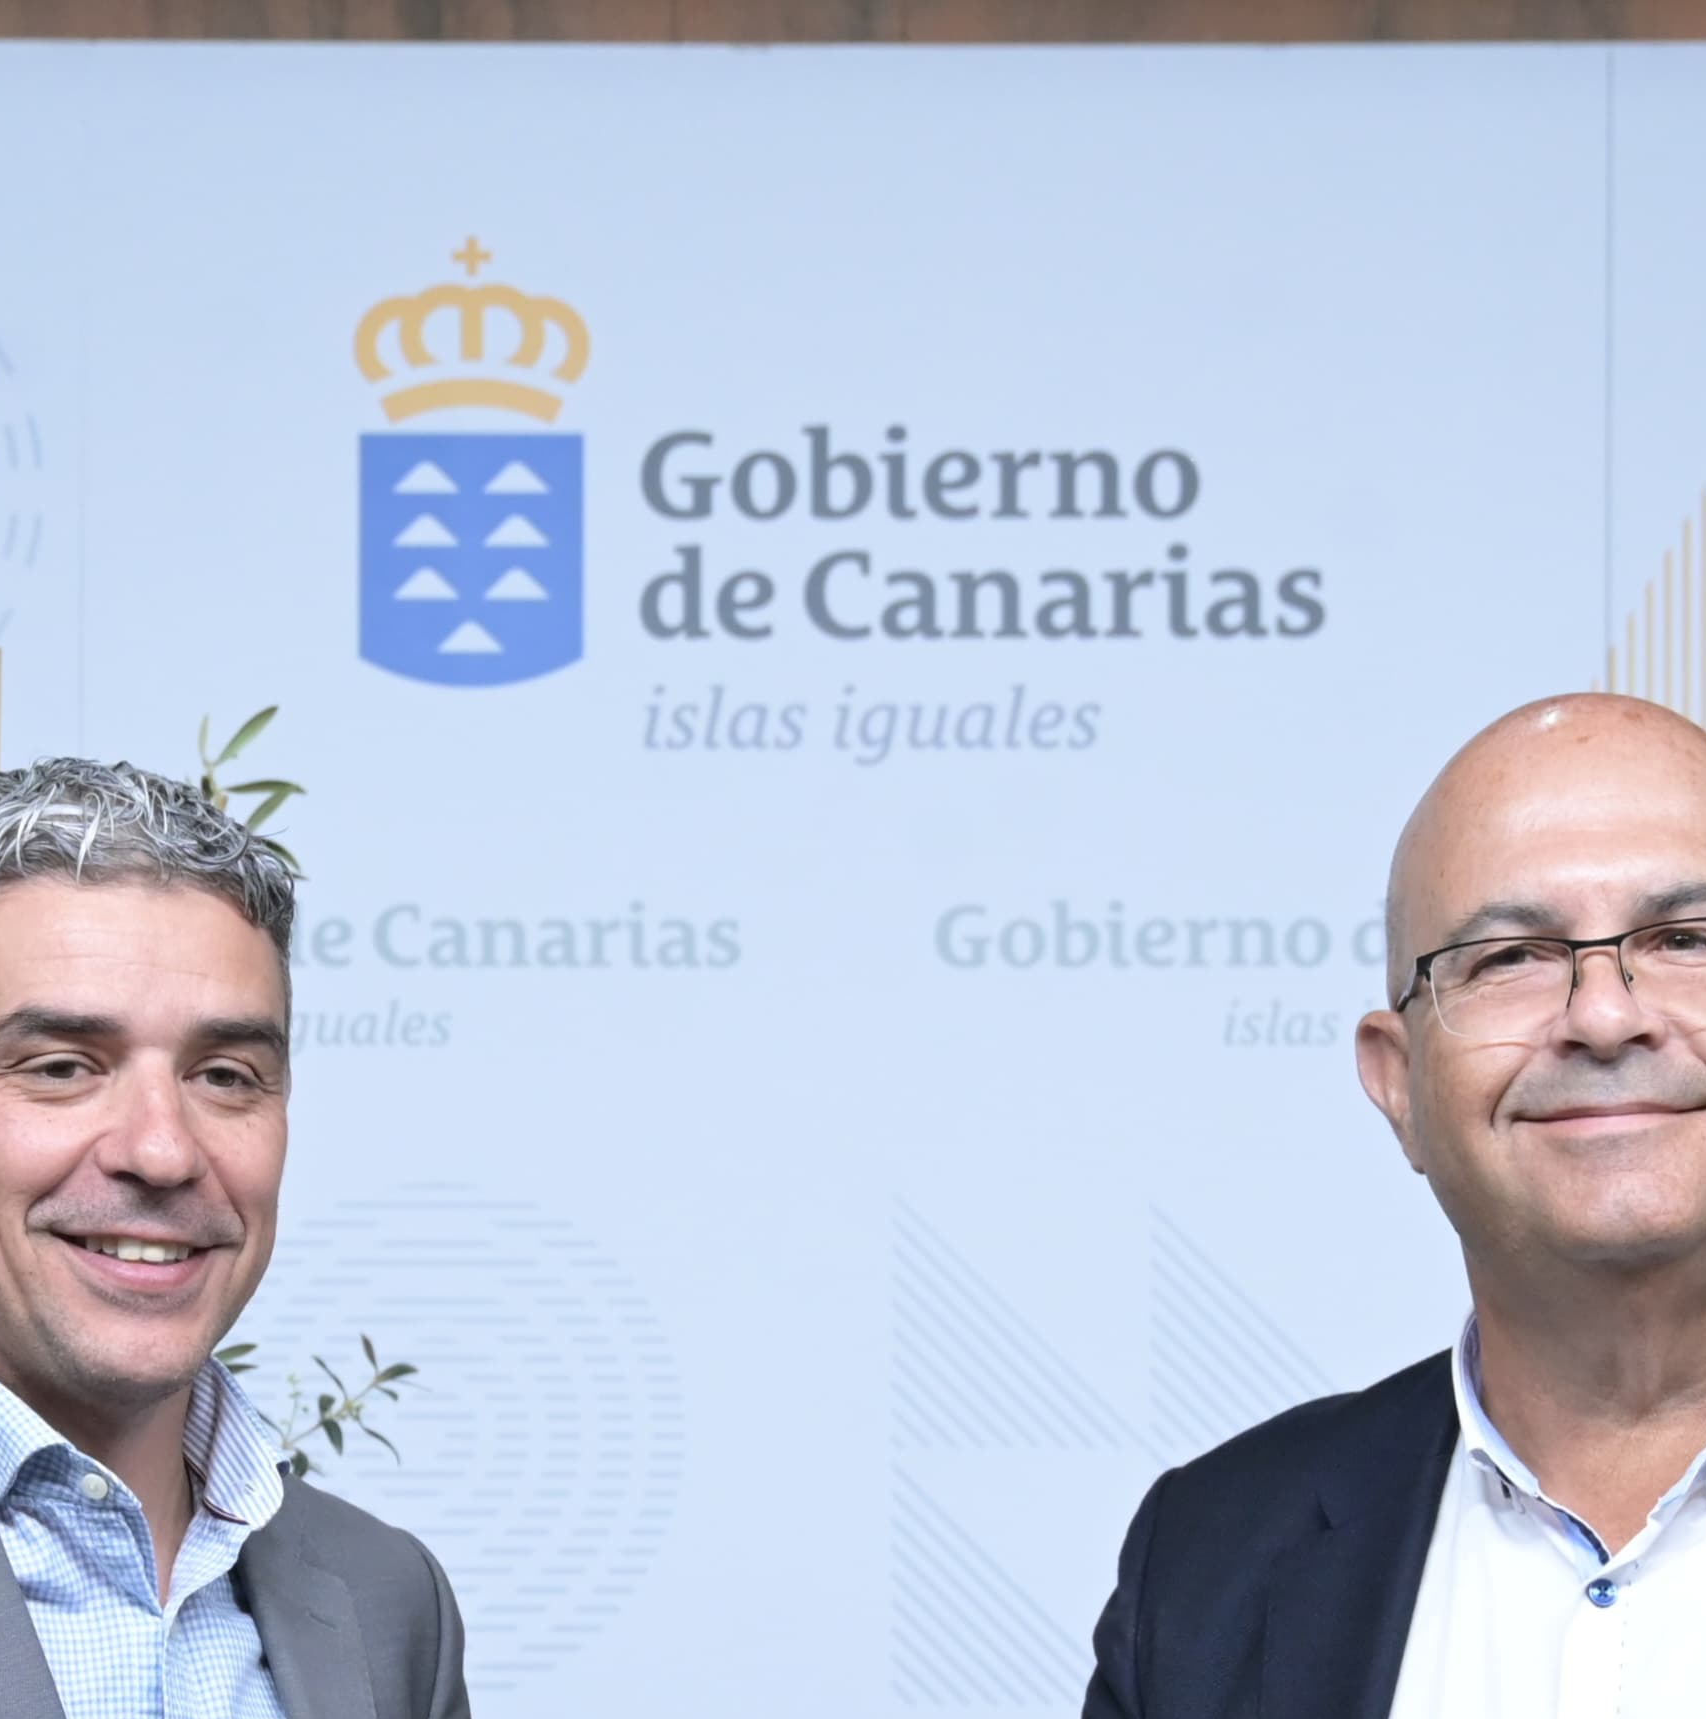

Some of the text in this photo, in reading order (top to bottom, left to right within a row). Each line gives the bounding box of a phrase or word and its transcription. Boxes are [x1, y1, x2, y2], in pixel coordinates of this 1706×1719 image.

[640, 423, 1201, 523] Gobierno
[640, 545, 1327, 640] de Canarias
[643, 685, 1100, 767] islas iguales
[372, 901, 742, 969] Canarias
[934, 899, 1331, 969] Gobierno
[1223, 1001, 1340, 1047] islas
